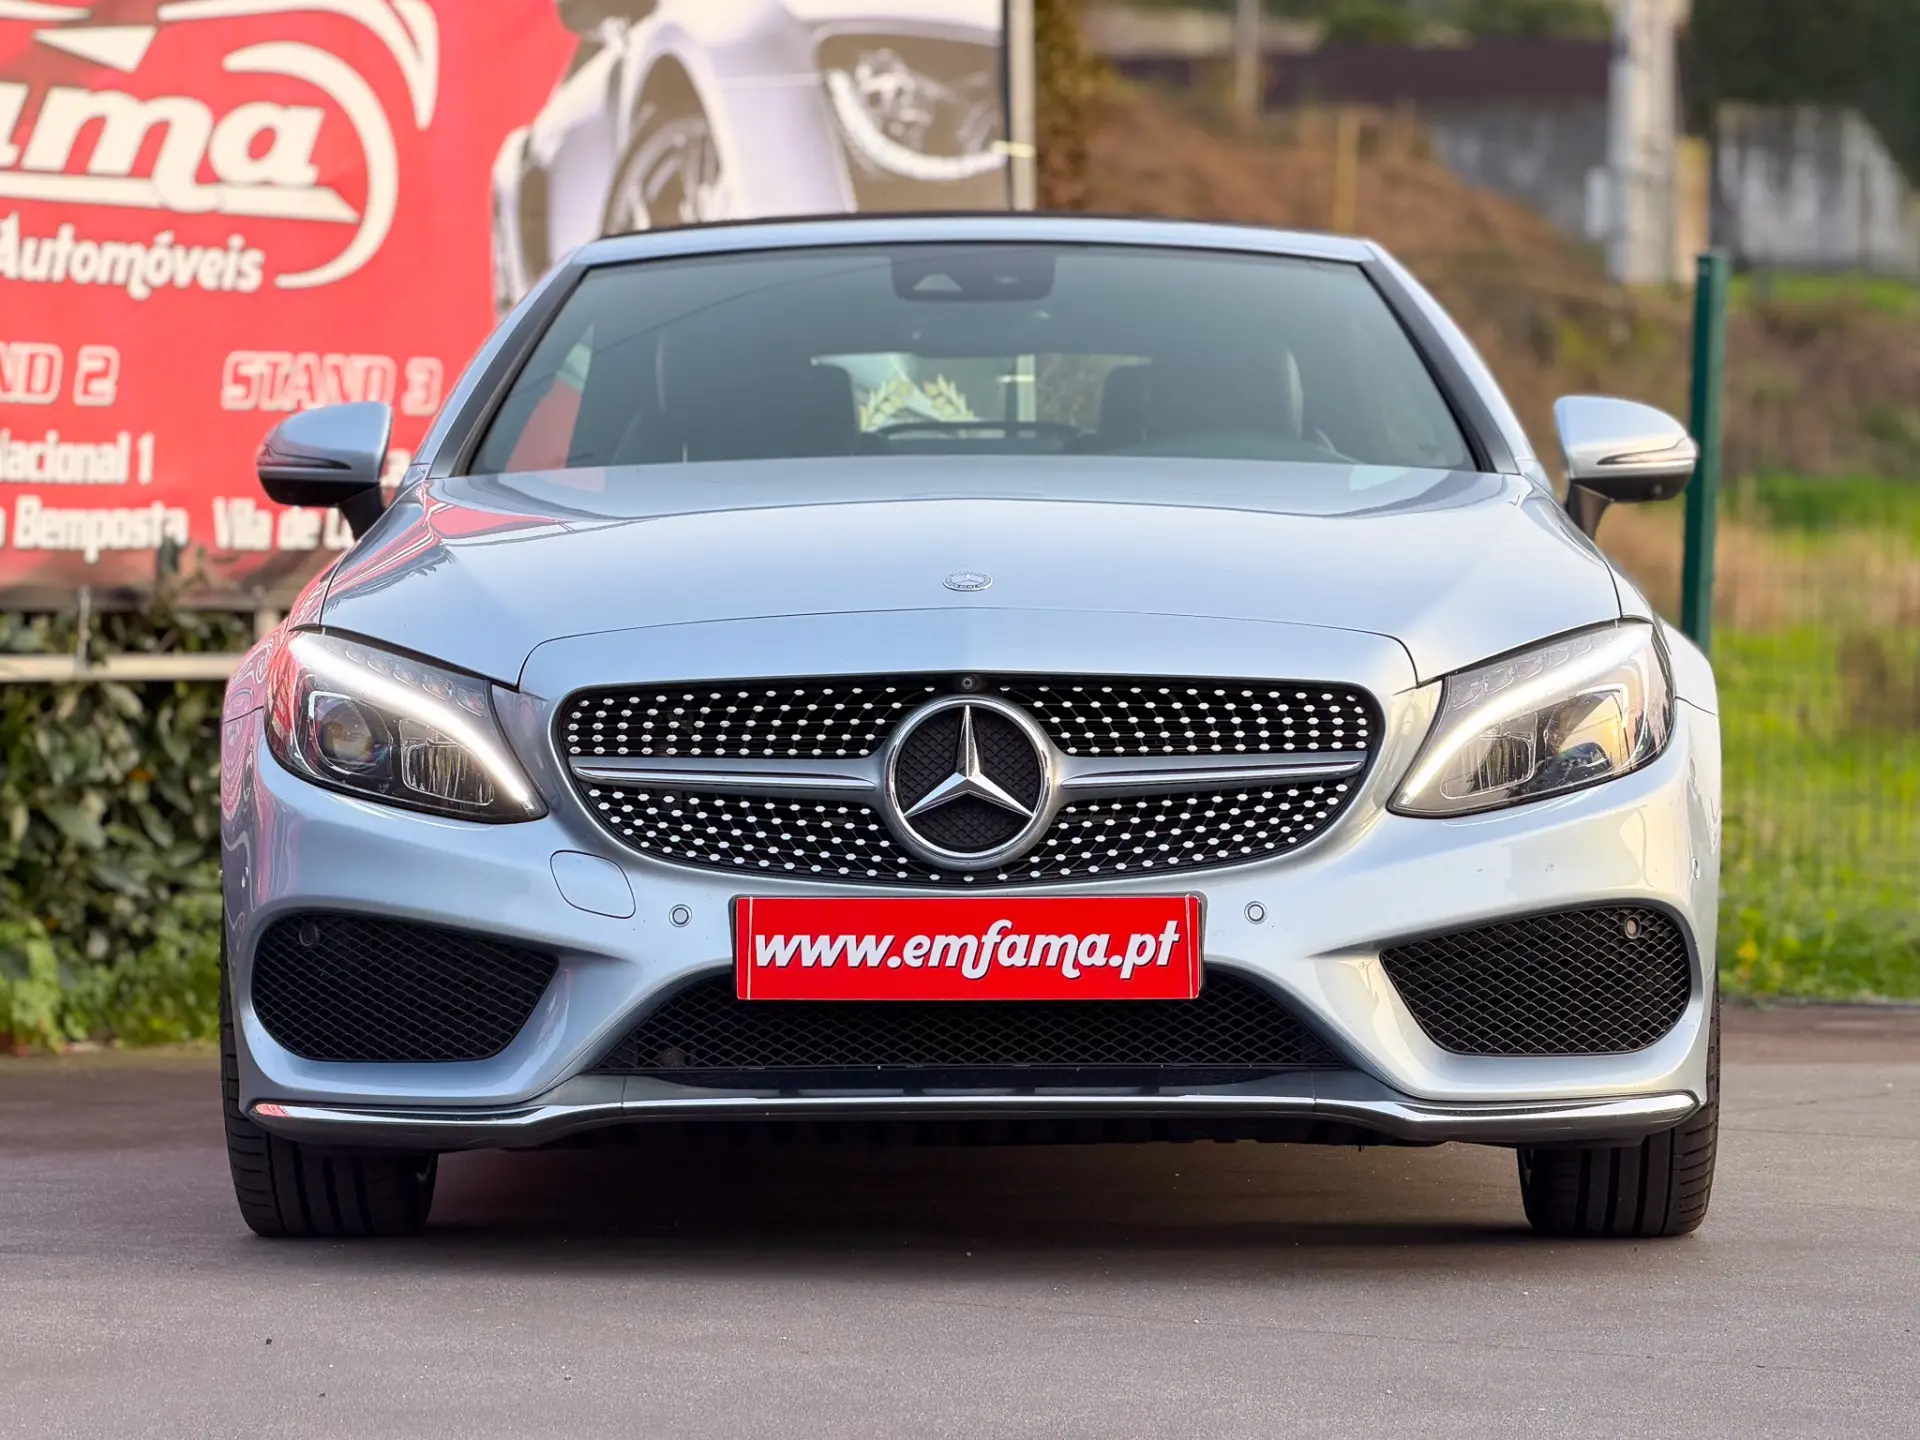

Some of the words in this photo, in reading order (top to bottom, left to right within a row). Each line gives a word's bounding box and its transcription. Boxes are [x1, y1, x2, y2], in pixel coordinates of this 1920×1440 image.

[73, 345, 120, 407] 2
[220, 350, 397, 412] STAND
[401, 356, 444, 417] 3
[136, 431, 155, 485] 1
[13, 494, 189, 563] Bemposta
[212, 496, 273, 551] Vila
[277, 504, 322, 551] de
[755, 919, 1180, 979] www.emfama.pt
